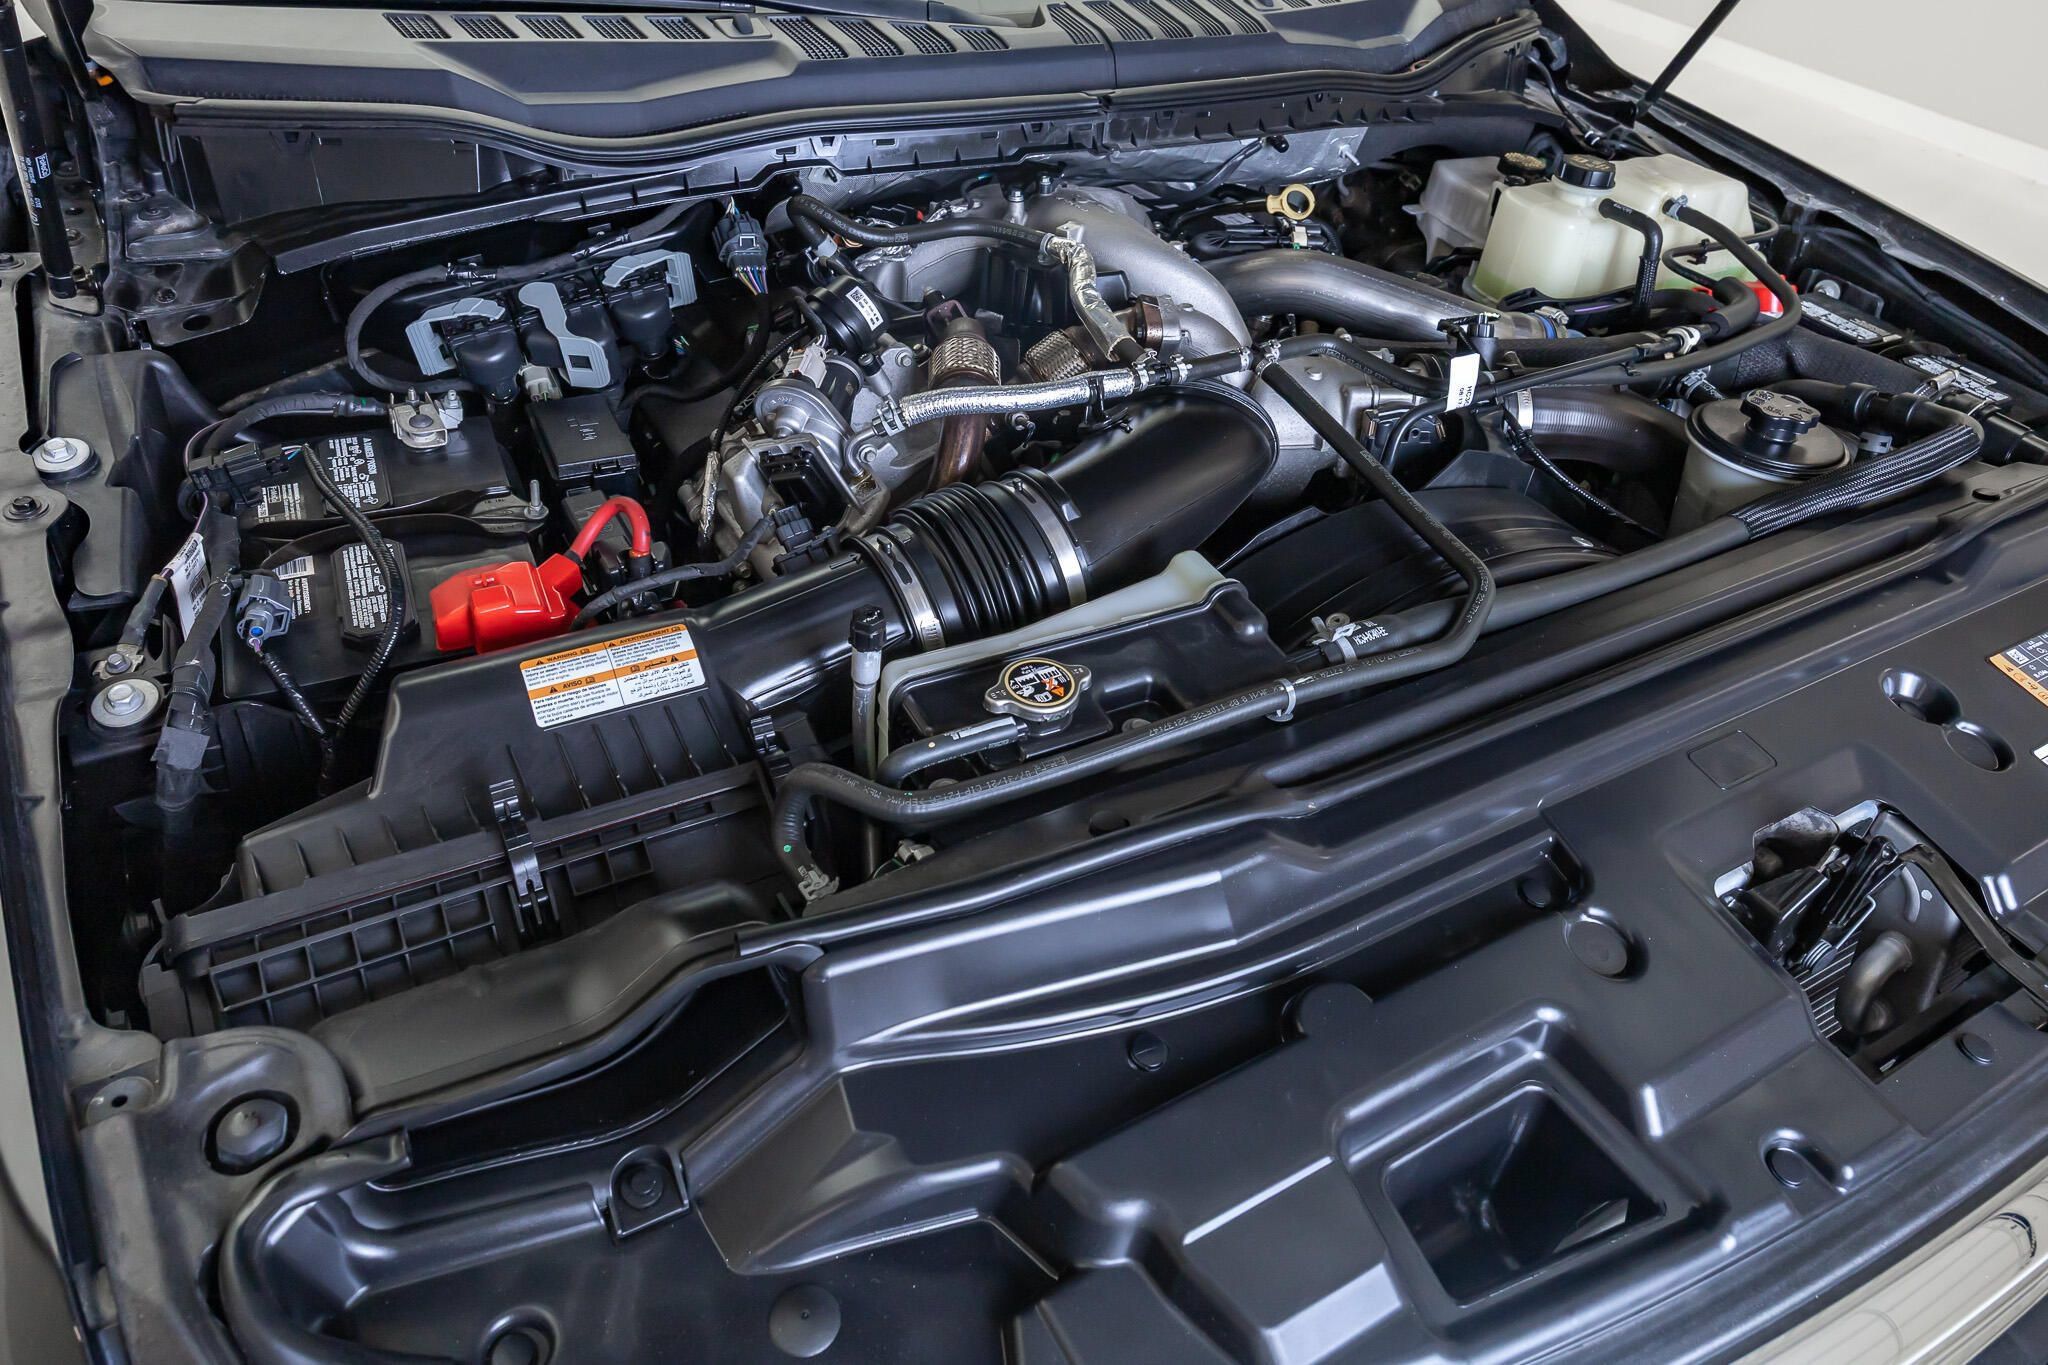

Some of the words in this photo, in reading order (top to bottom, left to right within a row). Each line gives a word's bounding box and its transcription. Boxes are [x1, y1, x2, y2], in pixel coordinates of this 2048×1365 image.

[38, 156, 48, 176] FoMoCo
[619, 628, 669, 644] AVERTISSEMENT
[546, 651, 577, 662] WARNING
[562, 679, 582, 689] AVISO
